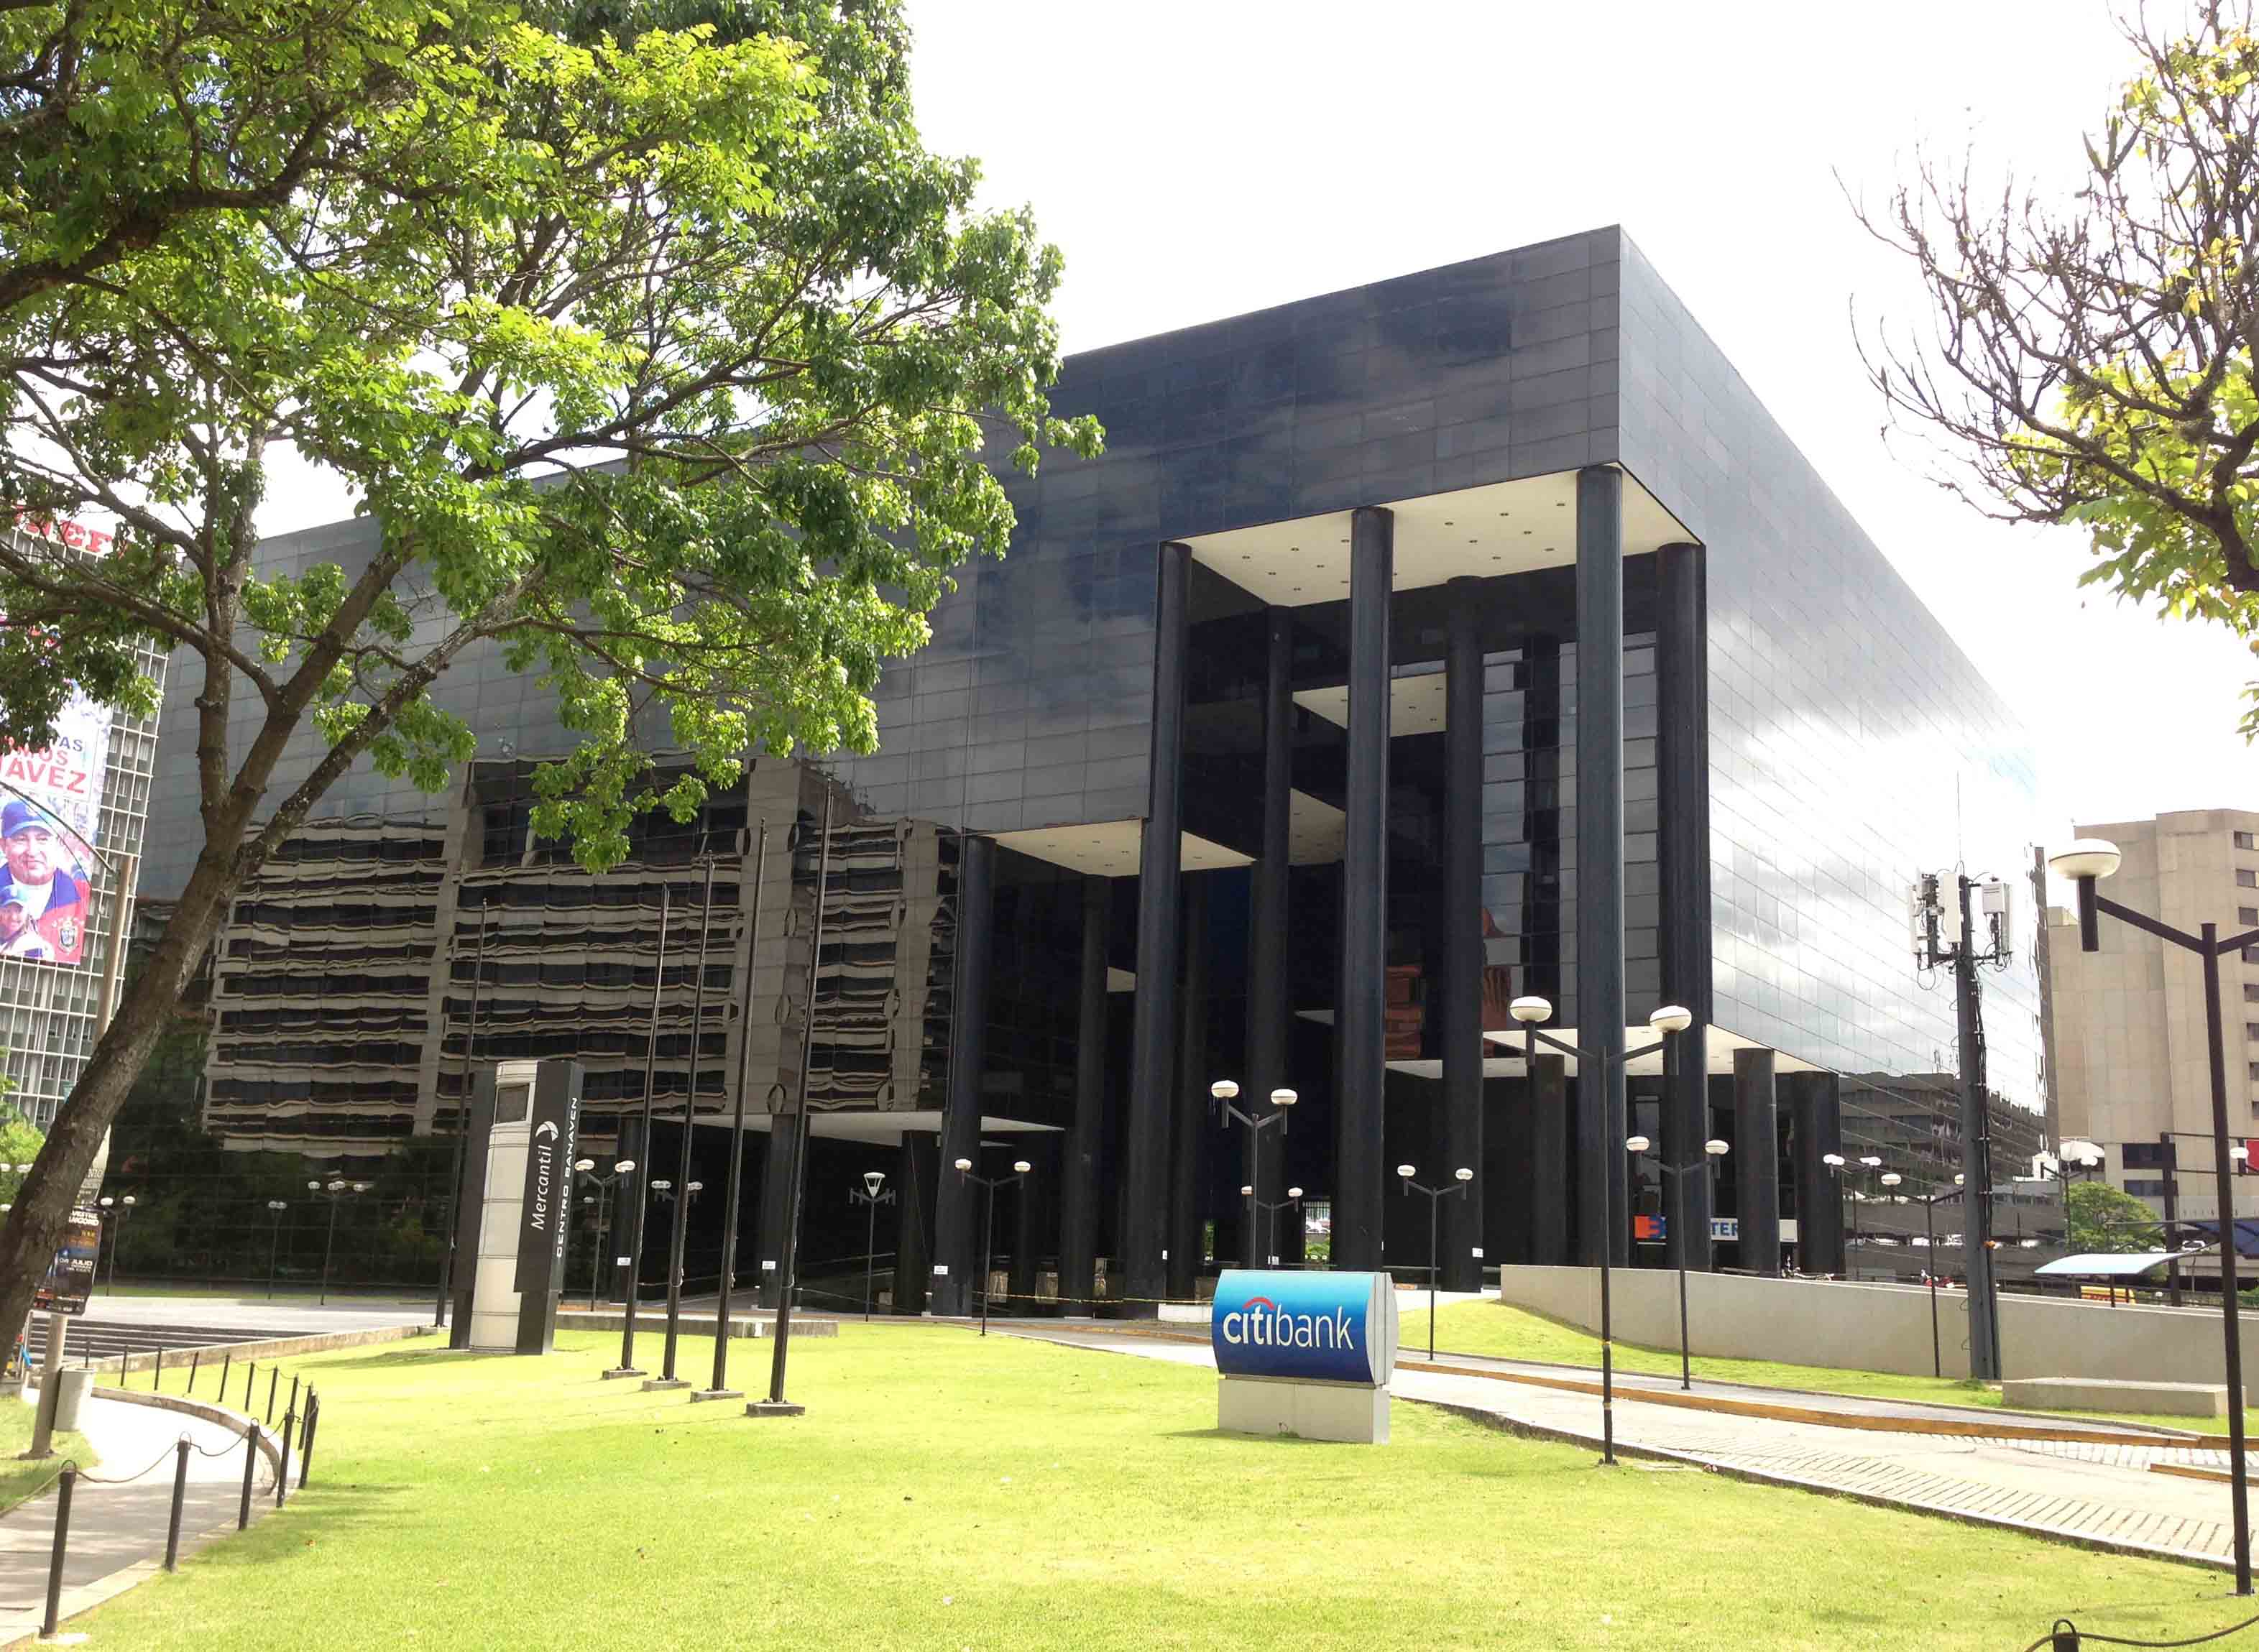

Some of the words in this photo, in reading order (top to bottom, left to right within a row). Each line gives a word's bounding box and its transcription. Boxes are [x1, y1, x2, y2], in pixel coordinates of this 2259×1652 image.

[0, 756, 87, 794] AVEZ
[530, 1144, 552, 1230] Mercantil
[556, 1185, 569, 1258] CENTRO
[565, 1097, 578, 1178] BANAVEN
[1223, 1301, 1355, 1350] citibank
